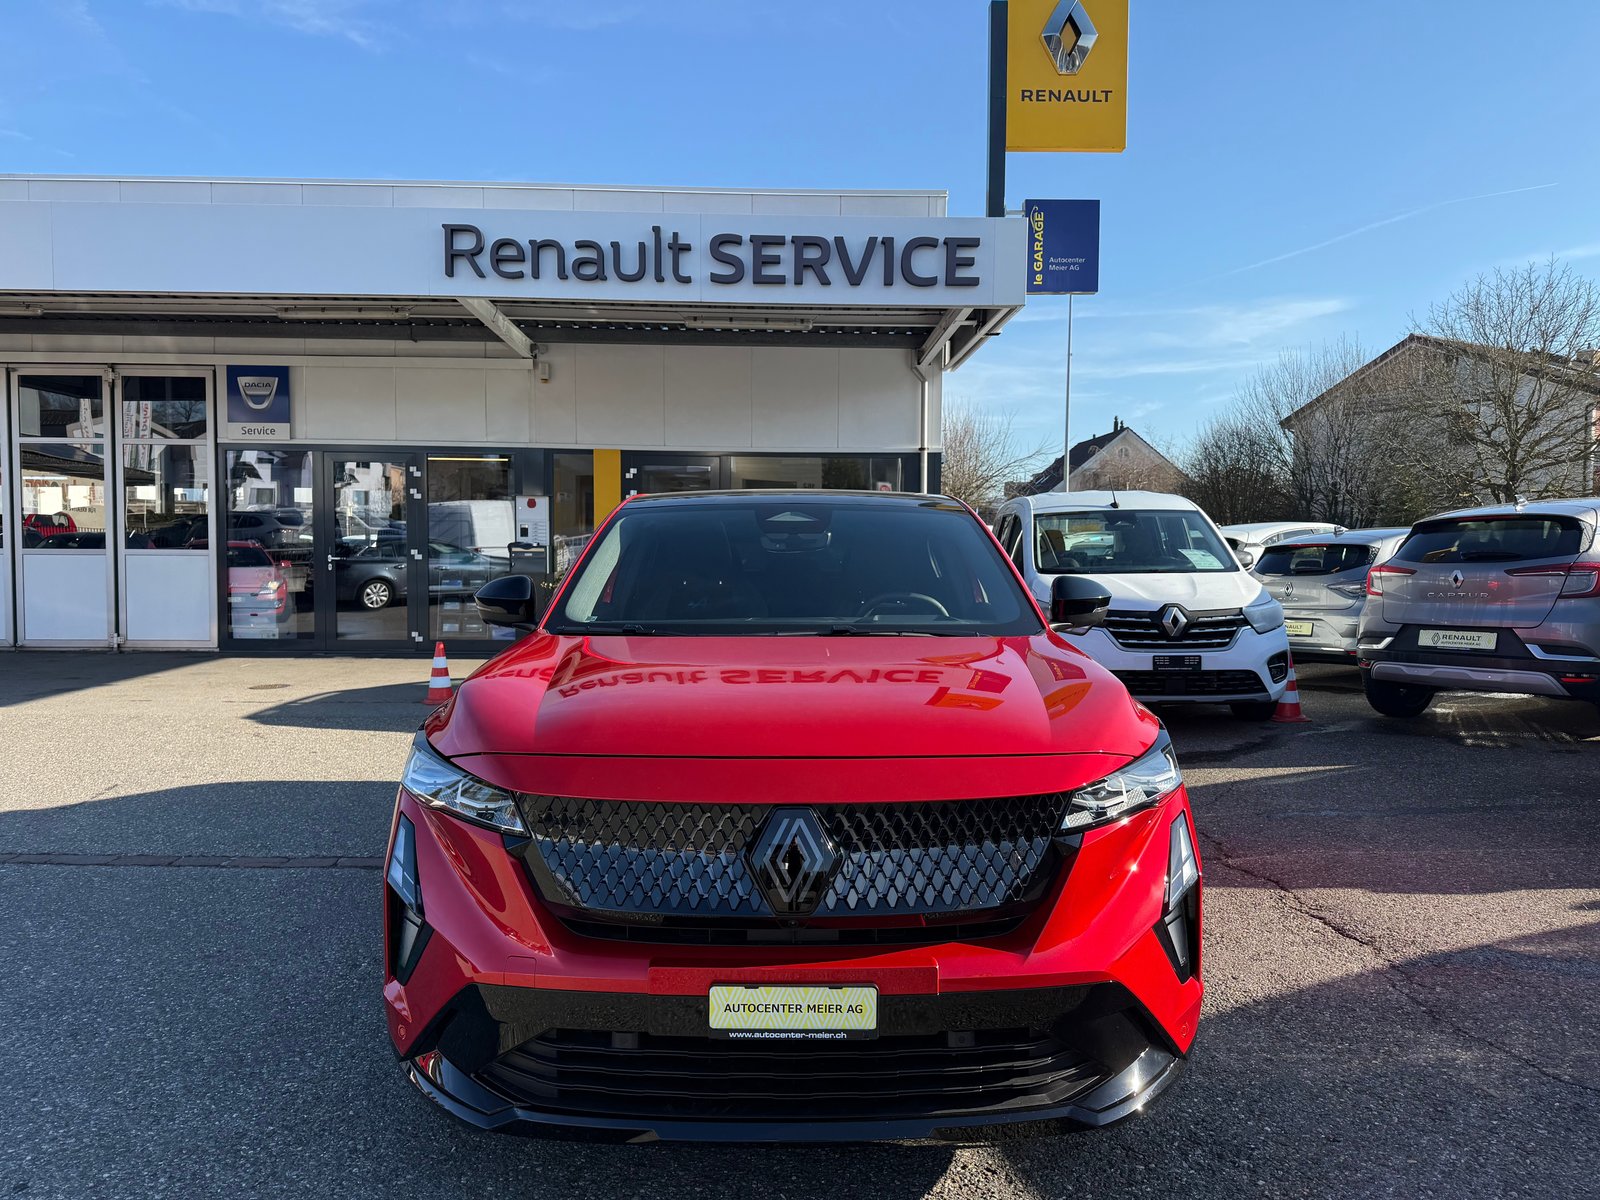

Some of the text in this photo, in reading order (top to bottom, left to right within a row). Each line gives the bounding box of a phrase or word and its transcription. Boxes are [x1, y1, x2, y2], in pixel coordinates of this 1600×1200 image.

[1021, 89, 1113, 102] RENAULT
[1033, 211, 1044, 285] le GARAGE
[442, 223, 982, 288] Renault SERVICE
[241, 426, 276, 435] Service
[1441, 634, 1482, 642] RENAULT
[724, 1003, 863, 1014] AUTOCENTER MEIER AG
[728, 1031, 847, 1039] www.autocenter-meier.ch
